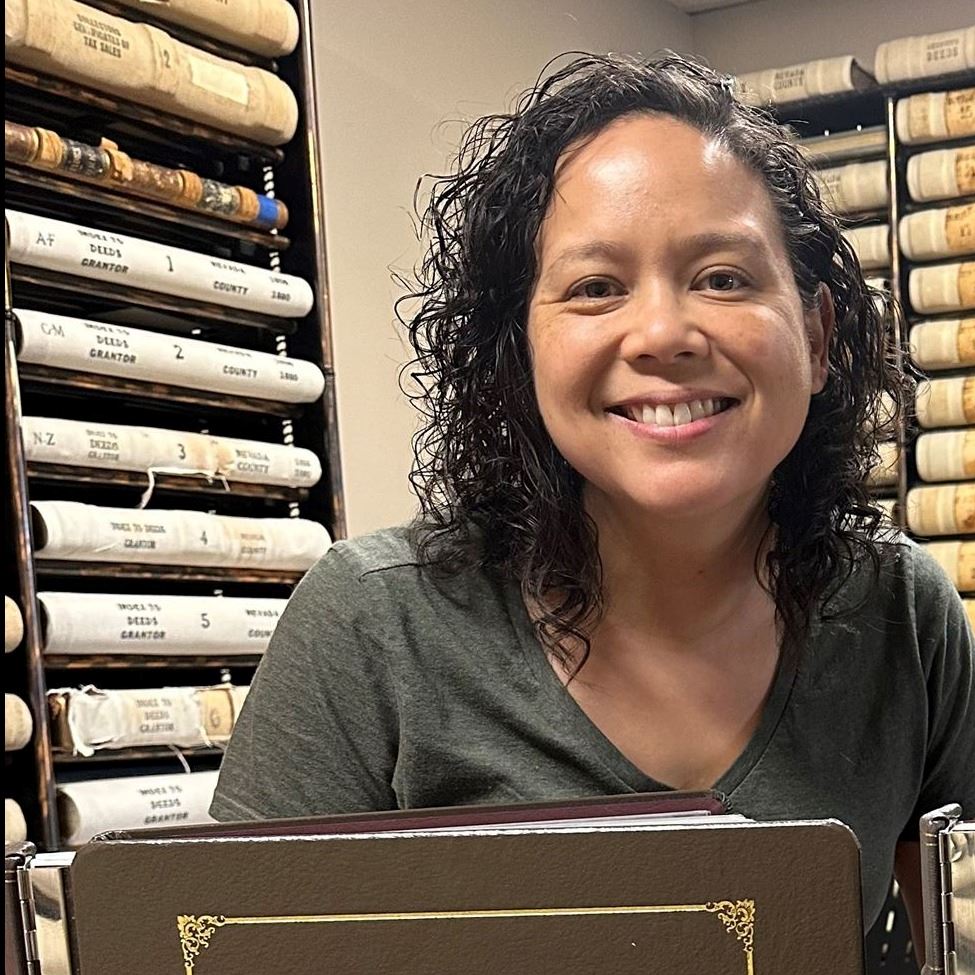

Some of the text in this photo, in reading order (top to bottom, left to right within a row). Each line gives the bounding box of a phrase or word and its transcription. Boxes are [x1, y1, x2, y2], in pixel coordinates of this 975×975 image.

[83, 35, 122, 58] TAX SALES
[163, 49, 171, 68] 2
[89, 244, 122, 259] DEEDS
[81, 258, 129, 273] GRANTOR
[166, 255, 174, 272] 1
[213, 280, 249, 296] COUNTY
[96, 335, 130, 349] DEEDS
[89, 348, 137, 364] GRANTOR
[173, 344, 185, 360] 2
[223, 364, 258, 378] COUNTY
[177, 443, 187, 460] 3
[235, 449, 271, 462] NEVADA
[237, 462, 271, 474] COUNTY
[200, 530, 208, 545] 4
[127, 616, 159, 627] DEEDS
[201, 612, 211, 629] 5
[120, 629, 166, 640] GRANTOR
[144, 811, 189, 825] GRANTOR
